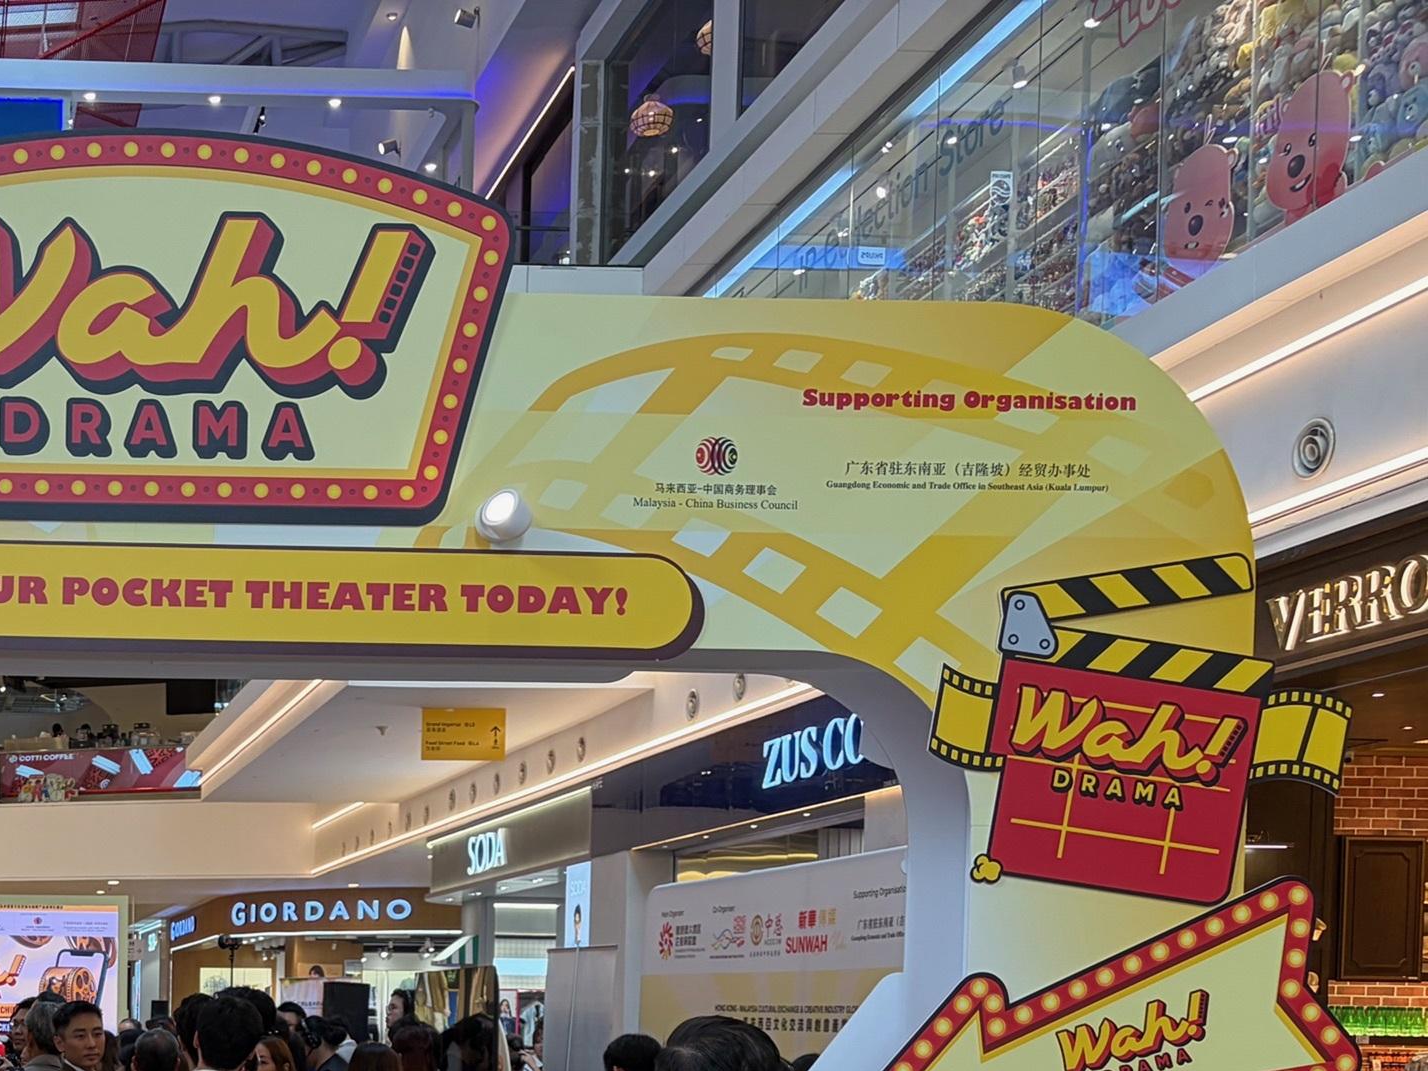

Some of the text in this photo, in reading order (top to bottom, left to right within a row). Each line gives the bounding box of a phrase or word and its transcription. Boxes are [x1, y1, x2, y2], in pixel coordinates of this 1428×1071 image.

[938, 100, 1005, 177] Store
[801, 388, 1138, 413] Supporting Organisation
[655, 482, 778, 496] 马来西亚-中国商务理事会
[826, 480, 1109, 493] Guangdong Economic and Trade Office in Southeast Asia (Kuala Lumpur)
[633, 498, 676, 510] Malaysia
[685, 498, 714, 510] China
[716, 499, 759, 510] Business
[761, 500, 798, 510] Council
[62, 576, 234, 608] POCKET
[245, 580, 448, 613] THEATER
[460, 583, 628, 617] TODAY!
[1009, 683, 1248, 787] Wah!
[19, 753, 76, 762] COTTI COFFEE
[762, 725, 819, 789] ZUS
[1051, 769, 1183, 811] DRAMA
[466, 828, 508, 876] SODA
[853, 885, 907, 900] Supporting Organisatio
[230, 898, 412, 927] GIORDANO
[785, 934, 828, 955] SUNWAH
